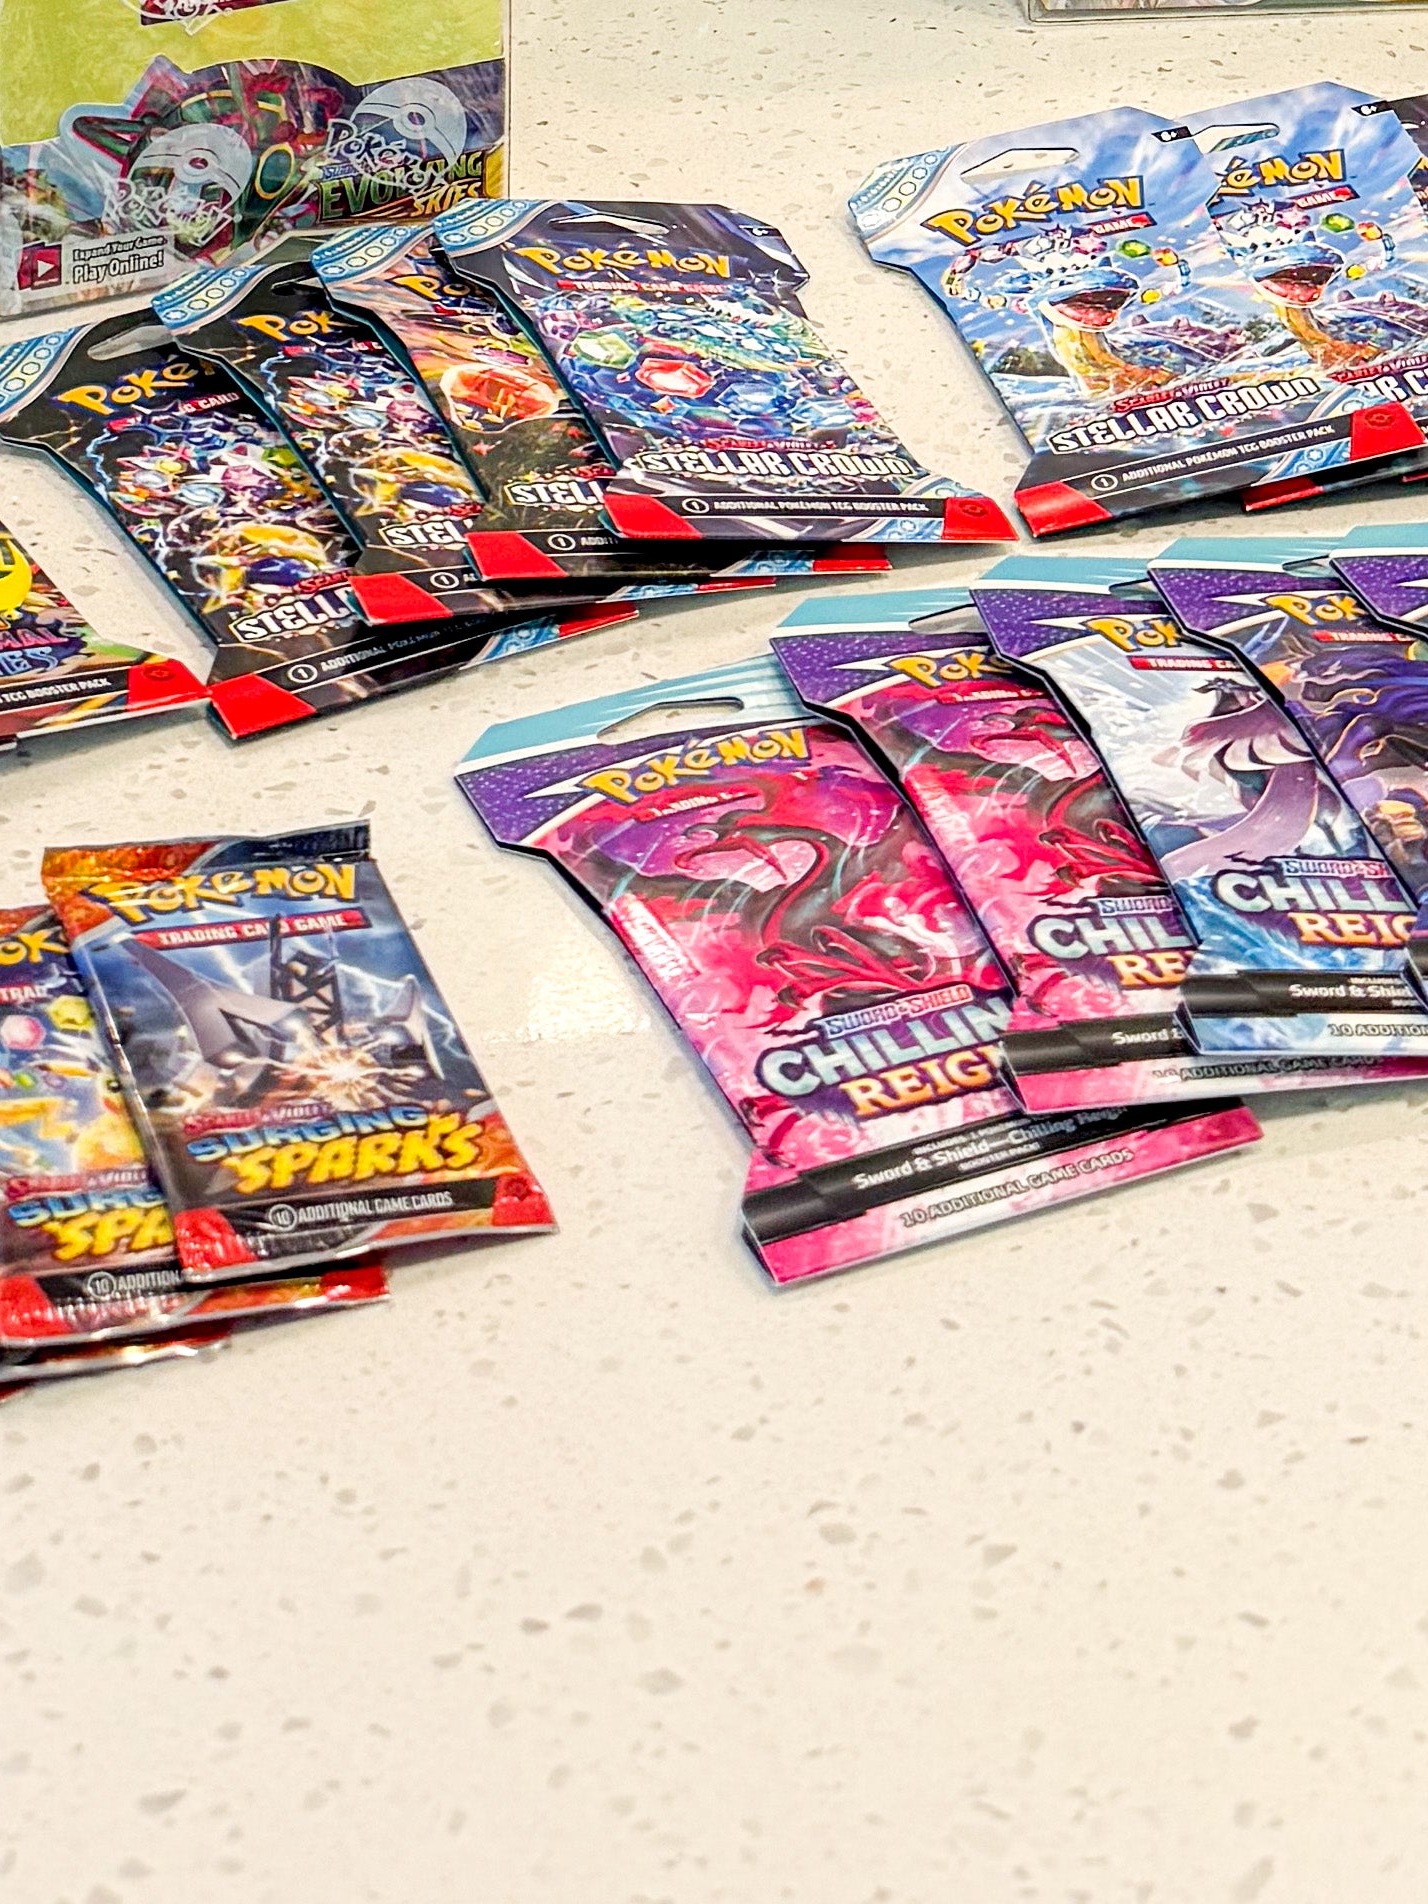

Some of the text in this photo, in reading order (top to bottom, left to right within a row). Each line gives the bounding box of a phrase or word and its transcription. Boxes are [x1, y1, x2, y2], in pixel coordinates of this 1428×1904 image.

[1296, 191, 1337, 207] GAME
[1092, 218, 1135, 236] GAME
[73, 251, 164, 285] Play Online!
[74, 243, 110, 261] Expand
[1049, 378, 1322, 453] STELLAR CROWN
[644, 451, 913, 478] STELLAR CROWN
[158, 913, 350, 947] TRADING GAME
[187, 1106, 429, 1162] SURGING
[222, 1112, 484, 1195] SPARKS
[1028, 1148, 1135, 1188] GAME CARDS
[852, 1162, 914, 1190] Sword
